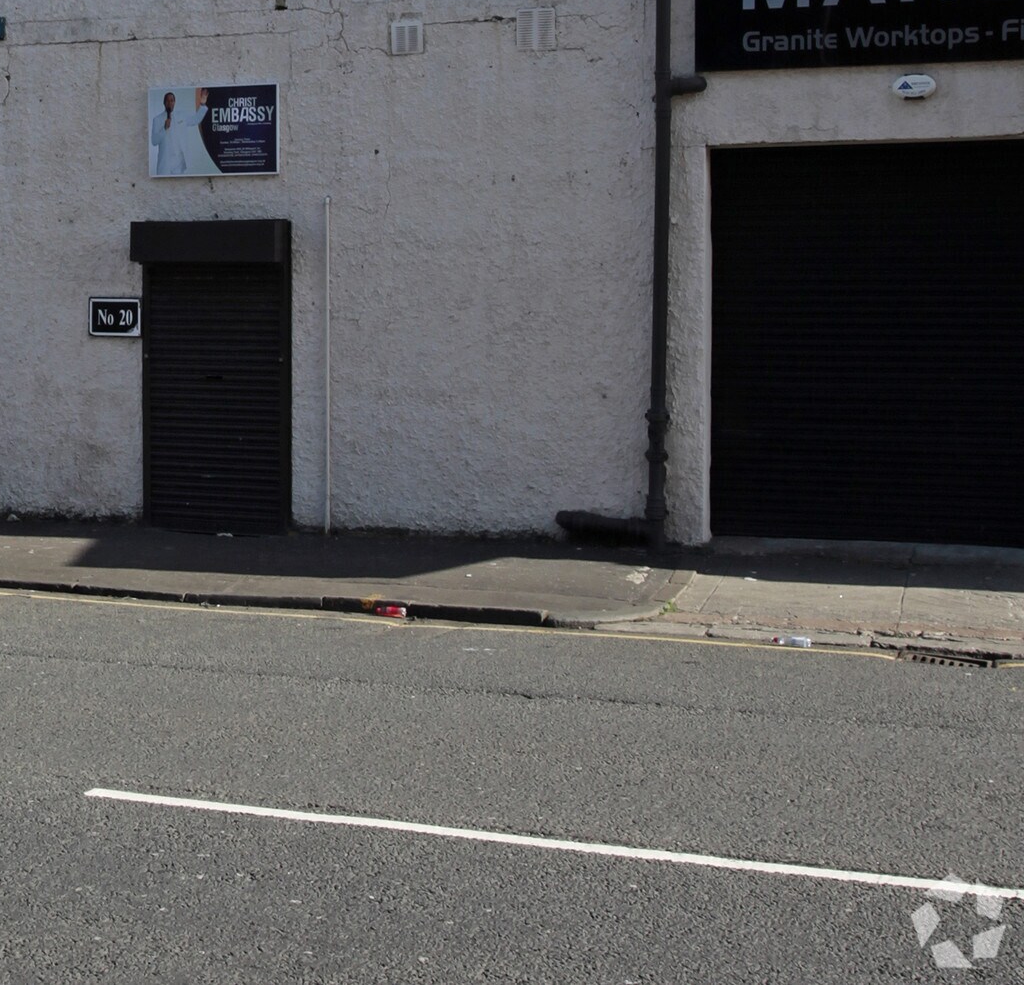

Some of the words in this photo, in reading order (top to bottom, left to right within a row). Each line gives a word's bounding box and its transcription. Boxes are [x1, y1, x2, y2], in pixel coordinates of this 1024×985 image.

[742, 31, 838, 52] Granite
[846, 24, 980, 50] Worktops
[228, 97, 257, 107] CHRIST
[211, 106, 274, 123] EMBASSY
[212, 124, 238, 133] Glasgow
[97, 309, 114, 325] No
[119, 309, 133, 325] 20
